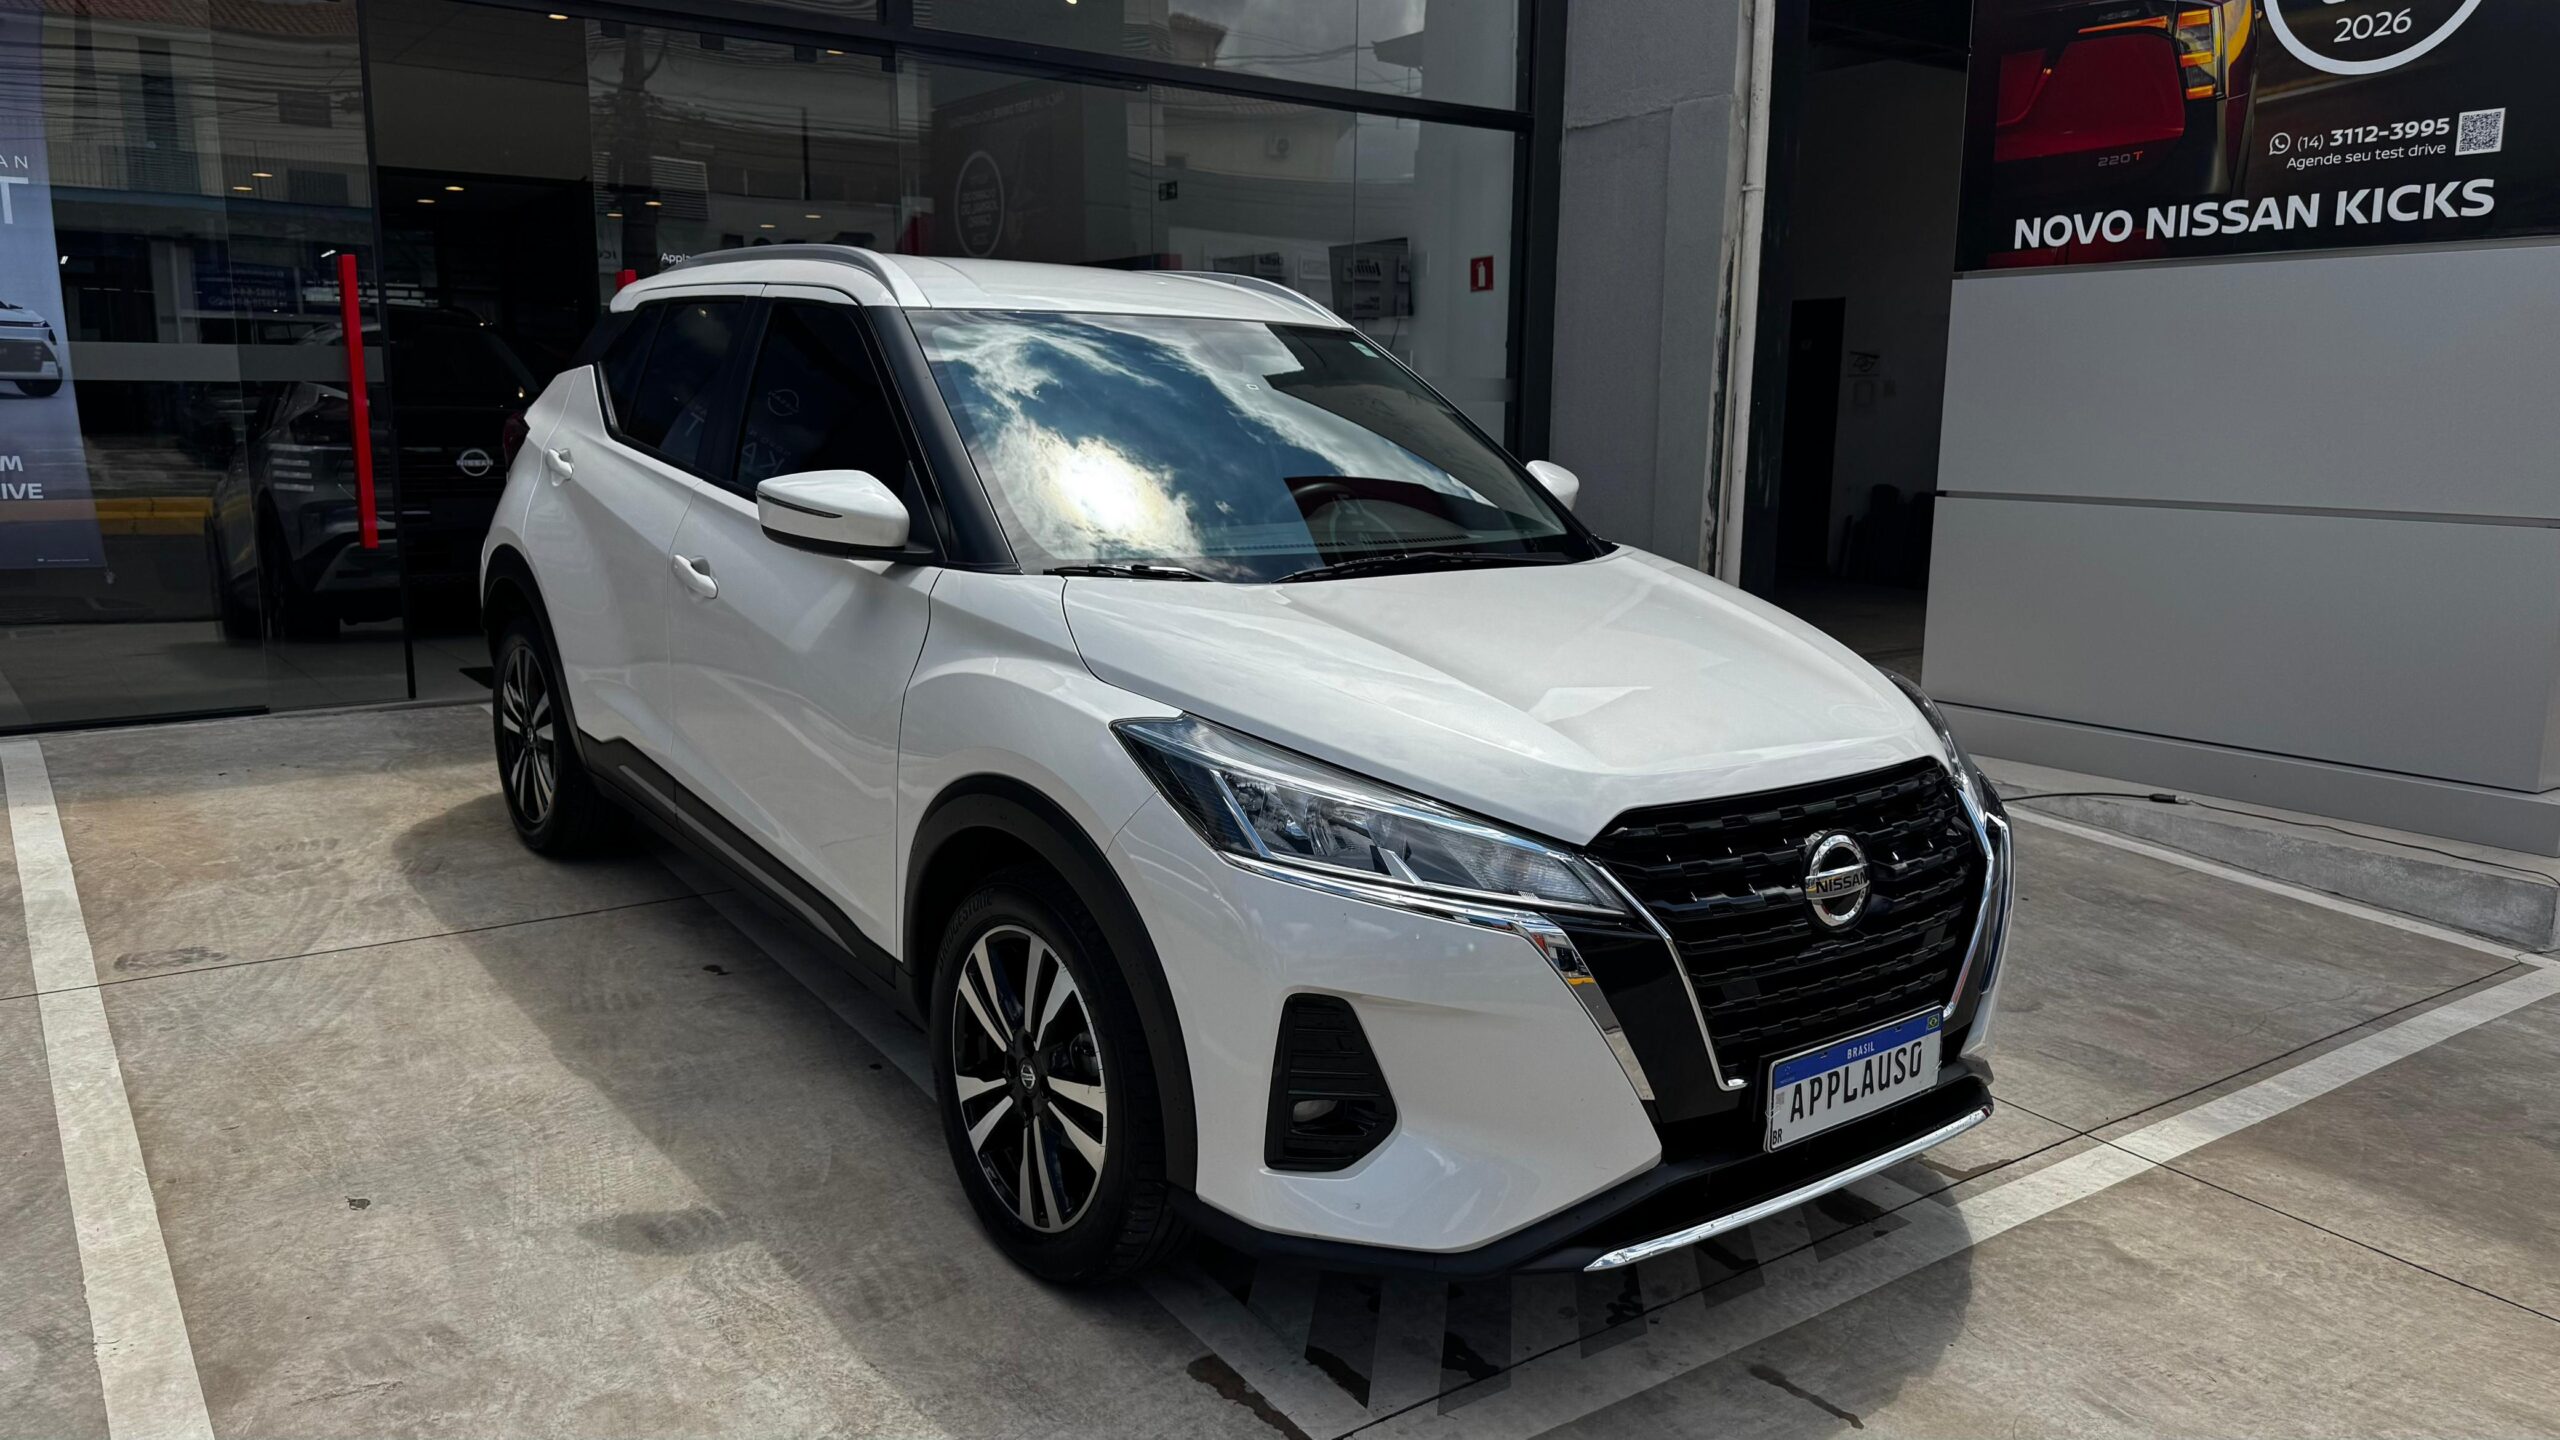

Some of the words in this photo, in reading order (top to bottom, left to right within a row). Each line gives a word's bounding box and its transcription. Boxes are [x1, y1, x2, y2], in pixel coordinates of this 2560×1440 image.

[2333, 7, 2413, 43] 2026
[2297, 135, 2324, 152] (14)
[2329, 117, 2450, 147] 3112-3995
[2286, 152, 2342, 170] Agende
[2345, 151, 2372, 164] seu
[2375, 147, 2404, 160] test
[2409, 142, 2446, 156] drive
[2013, 209, 2134, 250] NOVO
[2145, 192, 2320, 240] NISSAN
[2335, 178, 2496, 227] KICKS
[1815, 871, 1868, 894] NISSAN
[1846, 1040, 1876, 1060] BRASIL
[1789, 1041, 1923, 1123] APPLAUSO
[1772, 1128, 1783, 1145] BR
